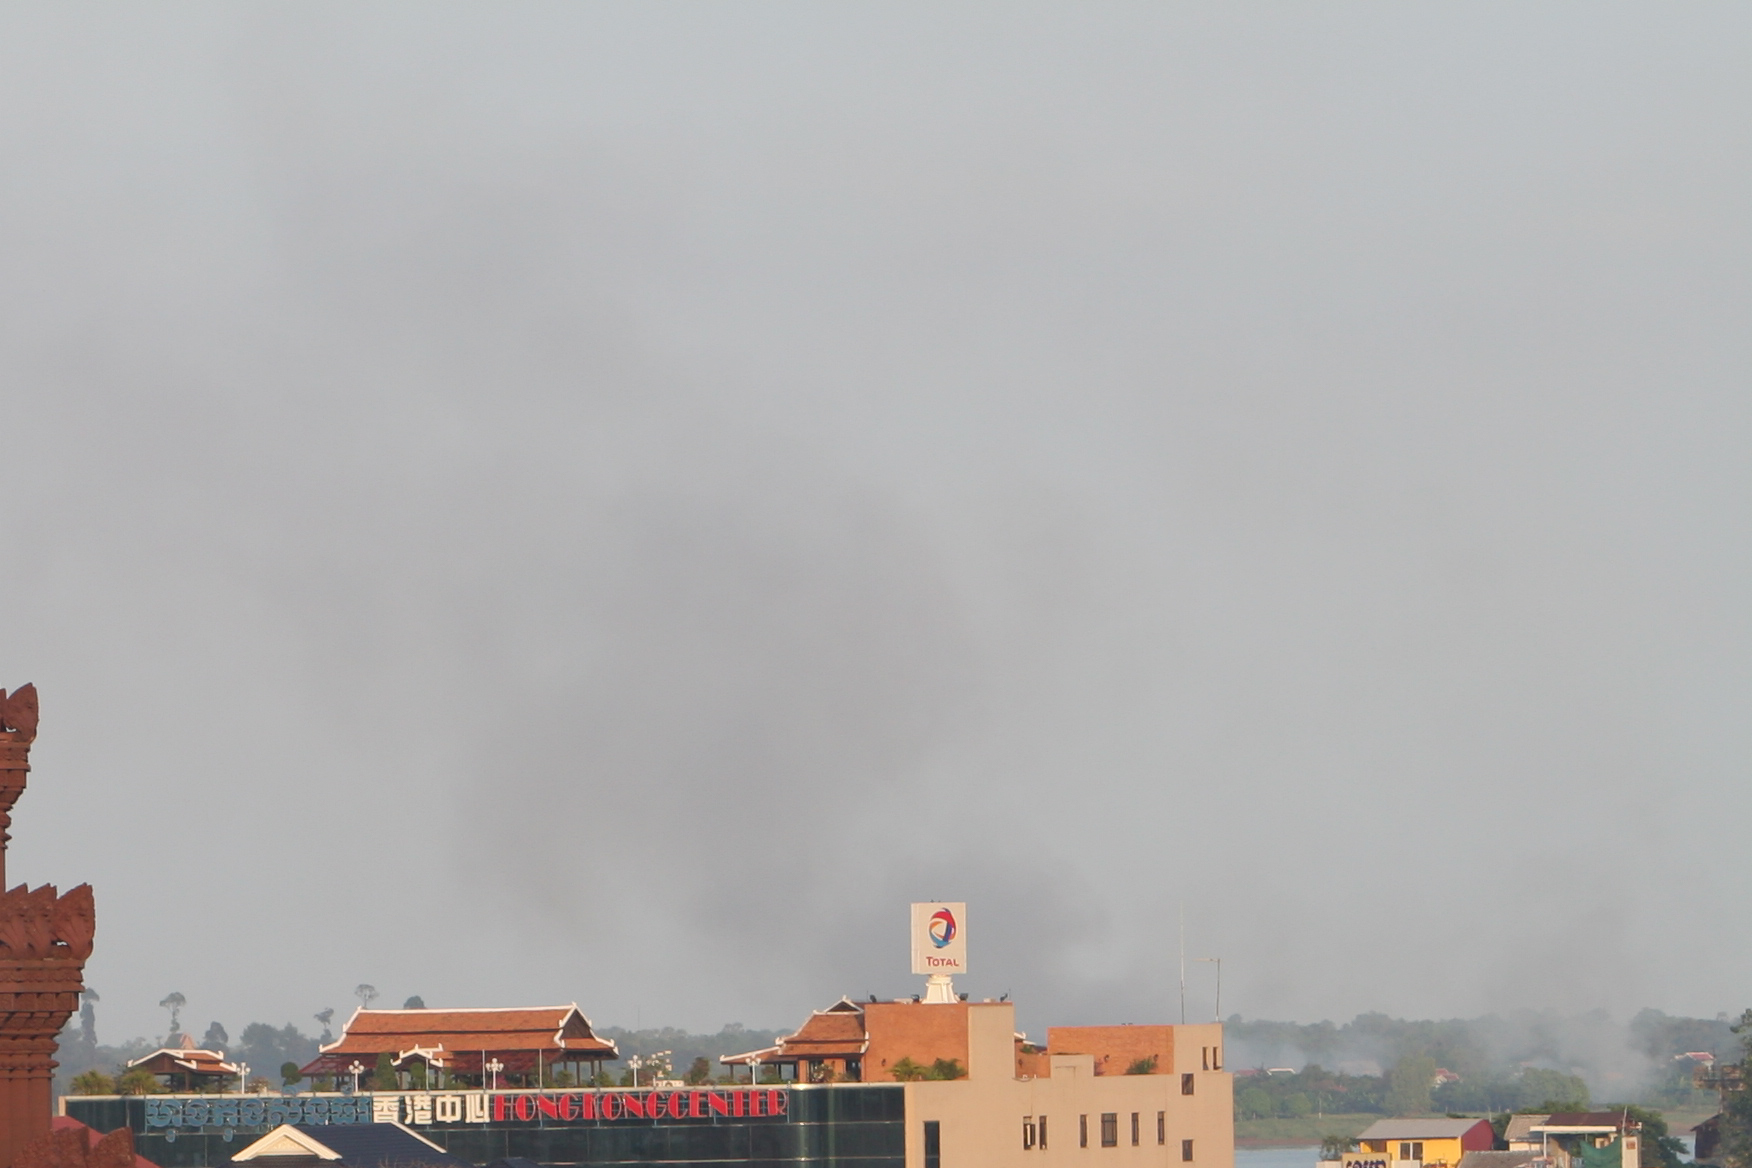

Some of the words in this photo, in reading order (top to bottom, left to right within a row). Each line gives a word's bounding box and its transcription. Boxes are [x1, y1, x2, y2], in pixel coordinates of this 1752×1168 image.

[926, 956, 960, 967] TOTAL
[373, 1095, 490, 1125] 香港中心
